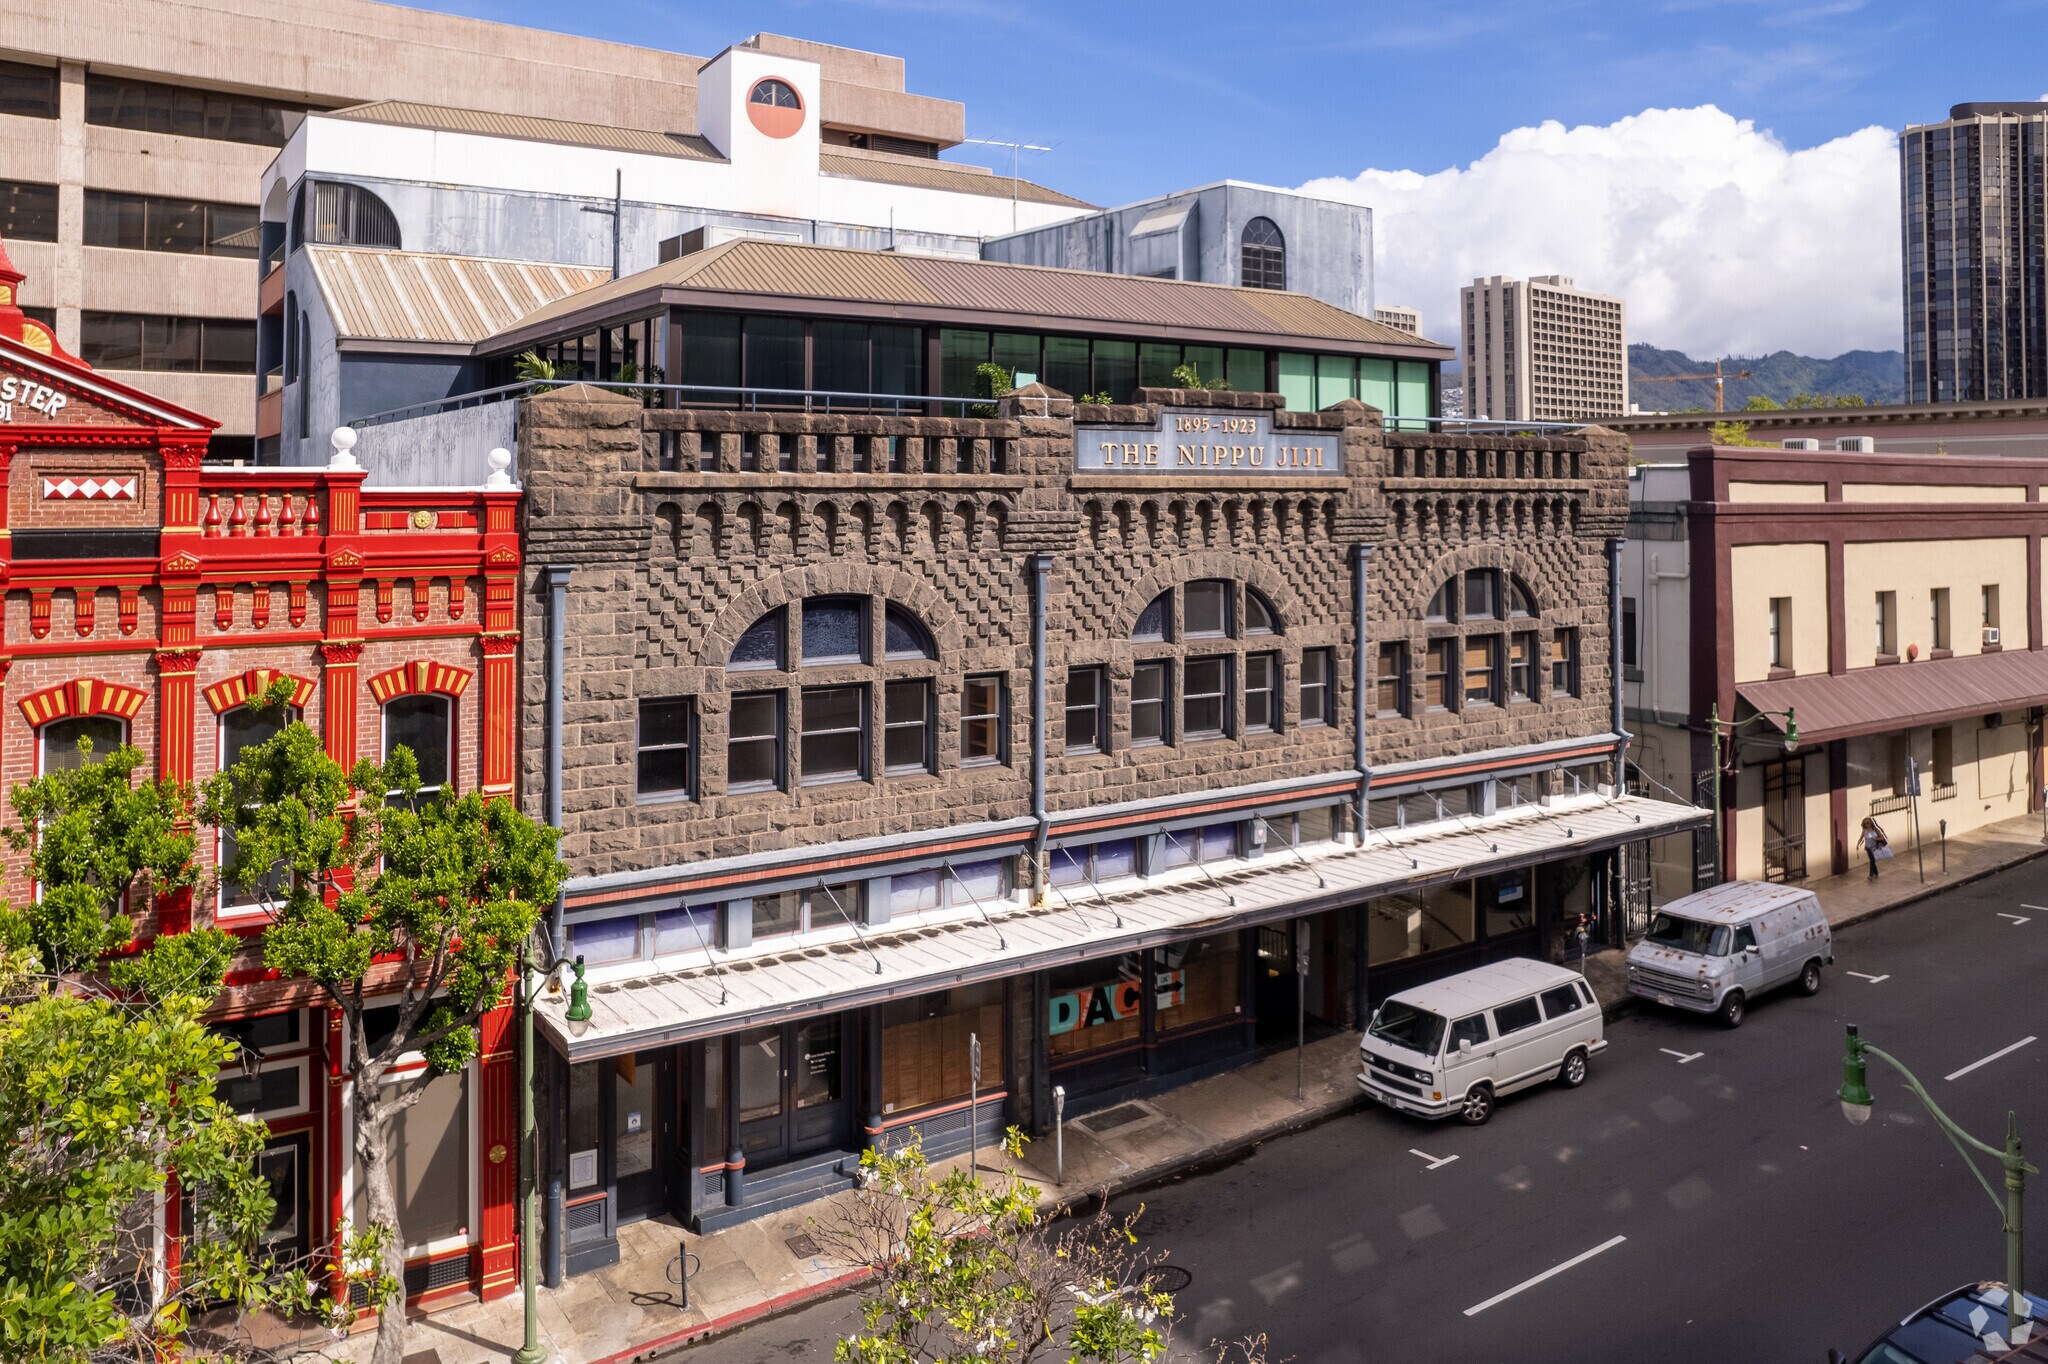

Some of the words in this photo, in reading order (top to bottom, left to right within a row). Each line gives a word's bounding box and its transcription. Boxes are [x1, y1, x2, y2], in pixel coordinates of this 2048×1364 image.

[1101, 442, 1160, 465] THE
[1177, 445, 1264, 466] NIPPU
[1277, 447, 1323, 467] JIJI
